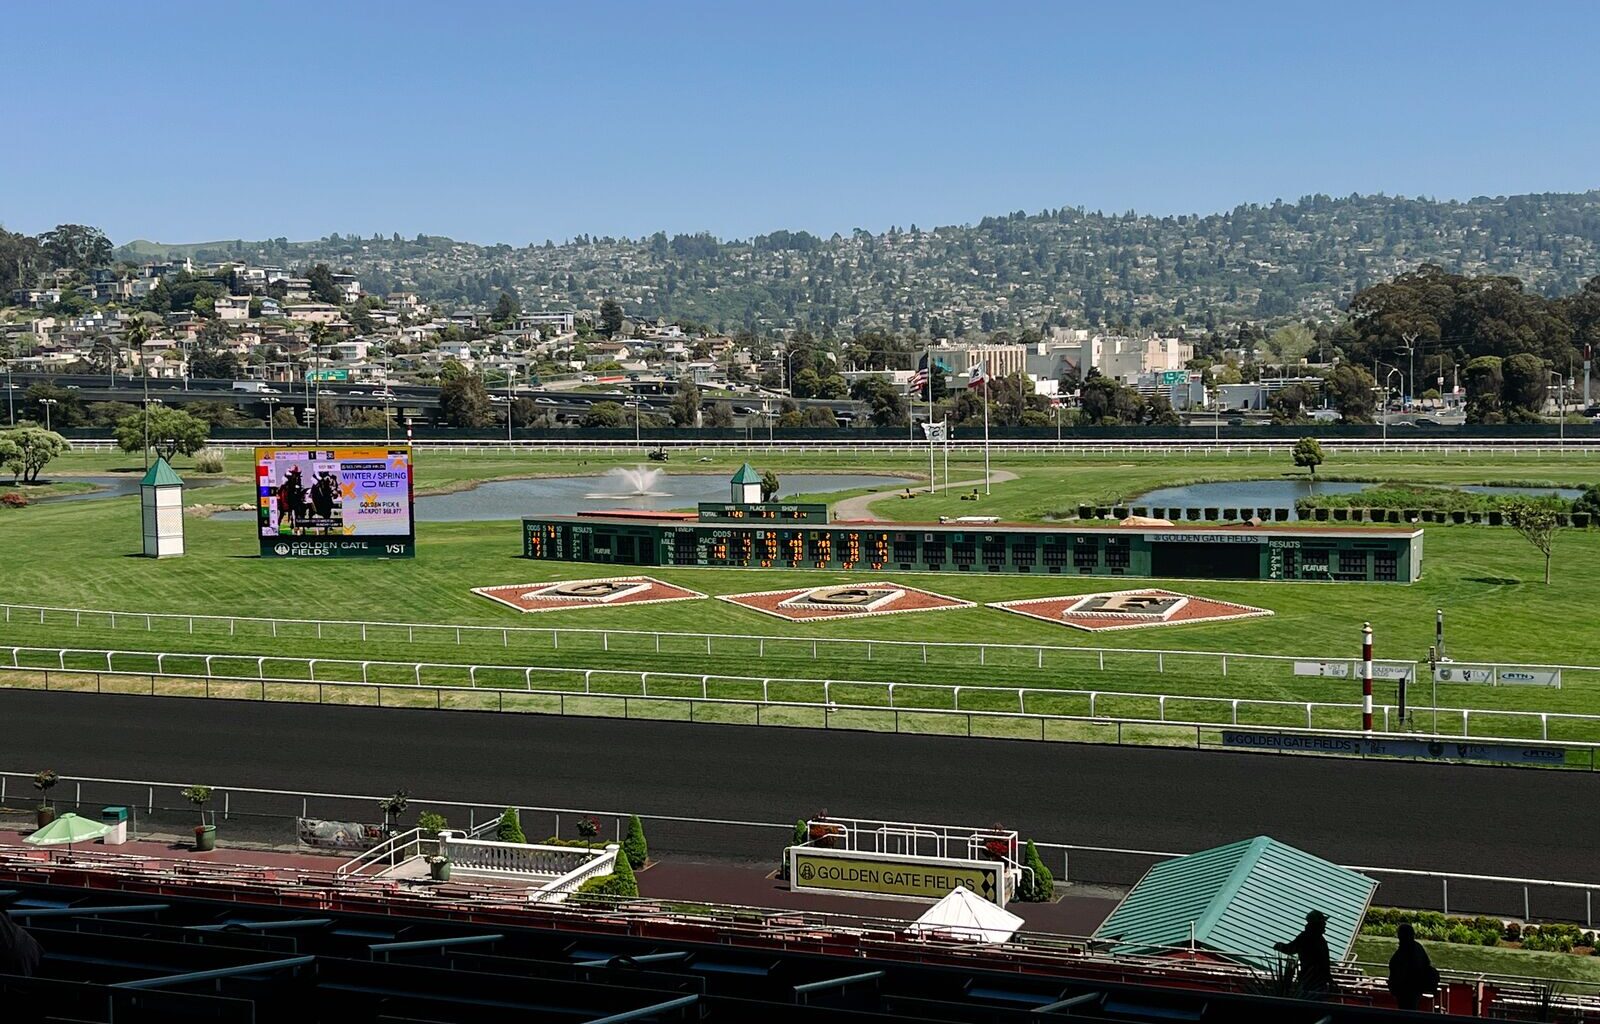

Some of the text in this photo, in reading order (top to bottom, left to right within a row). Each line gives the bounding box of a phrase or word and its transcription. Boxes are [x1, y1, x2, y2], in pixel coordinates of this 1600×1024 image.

[1092, 595, 1153, 612] F
[1236, 734, 1350, 750] GOLDEN GATE FIELDS
[818, 866, 975, 891] GOLDEN GATE FIELDS
